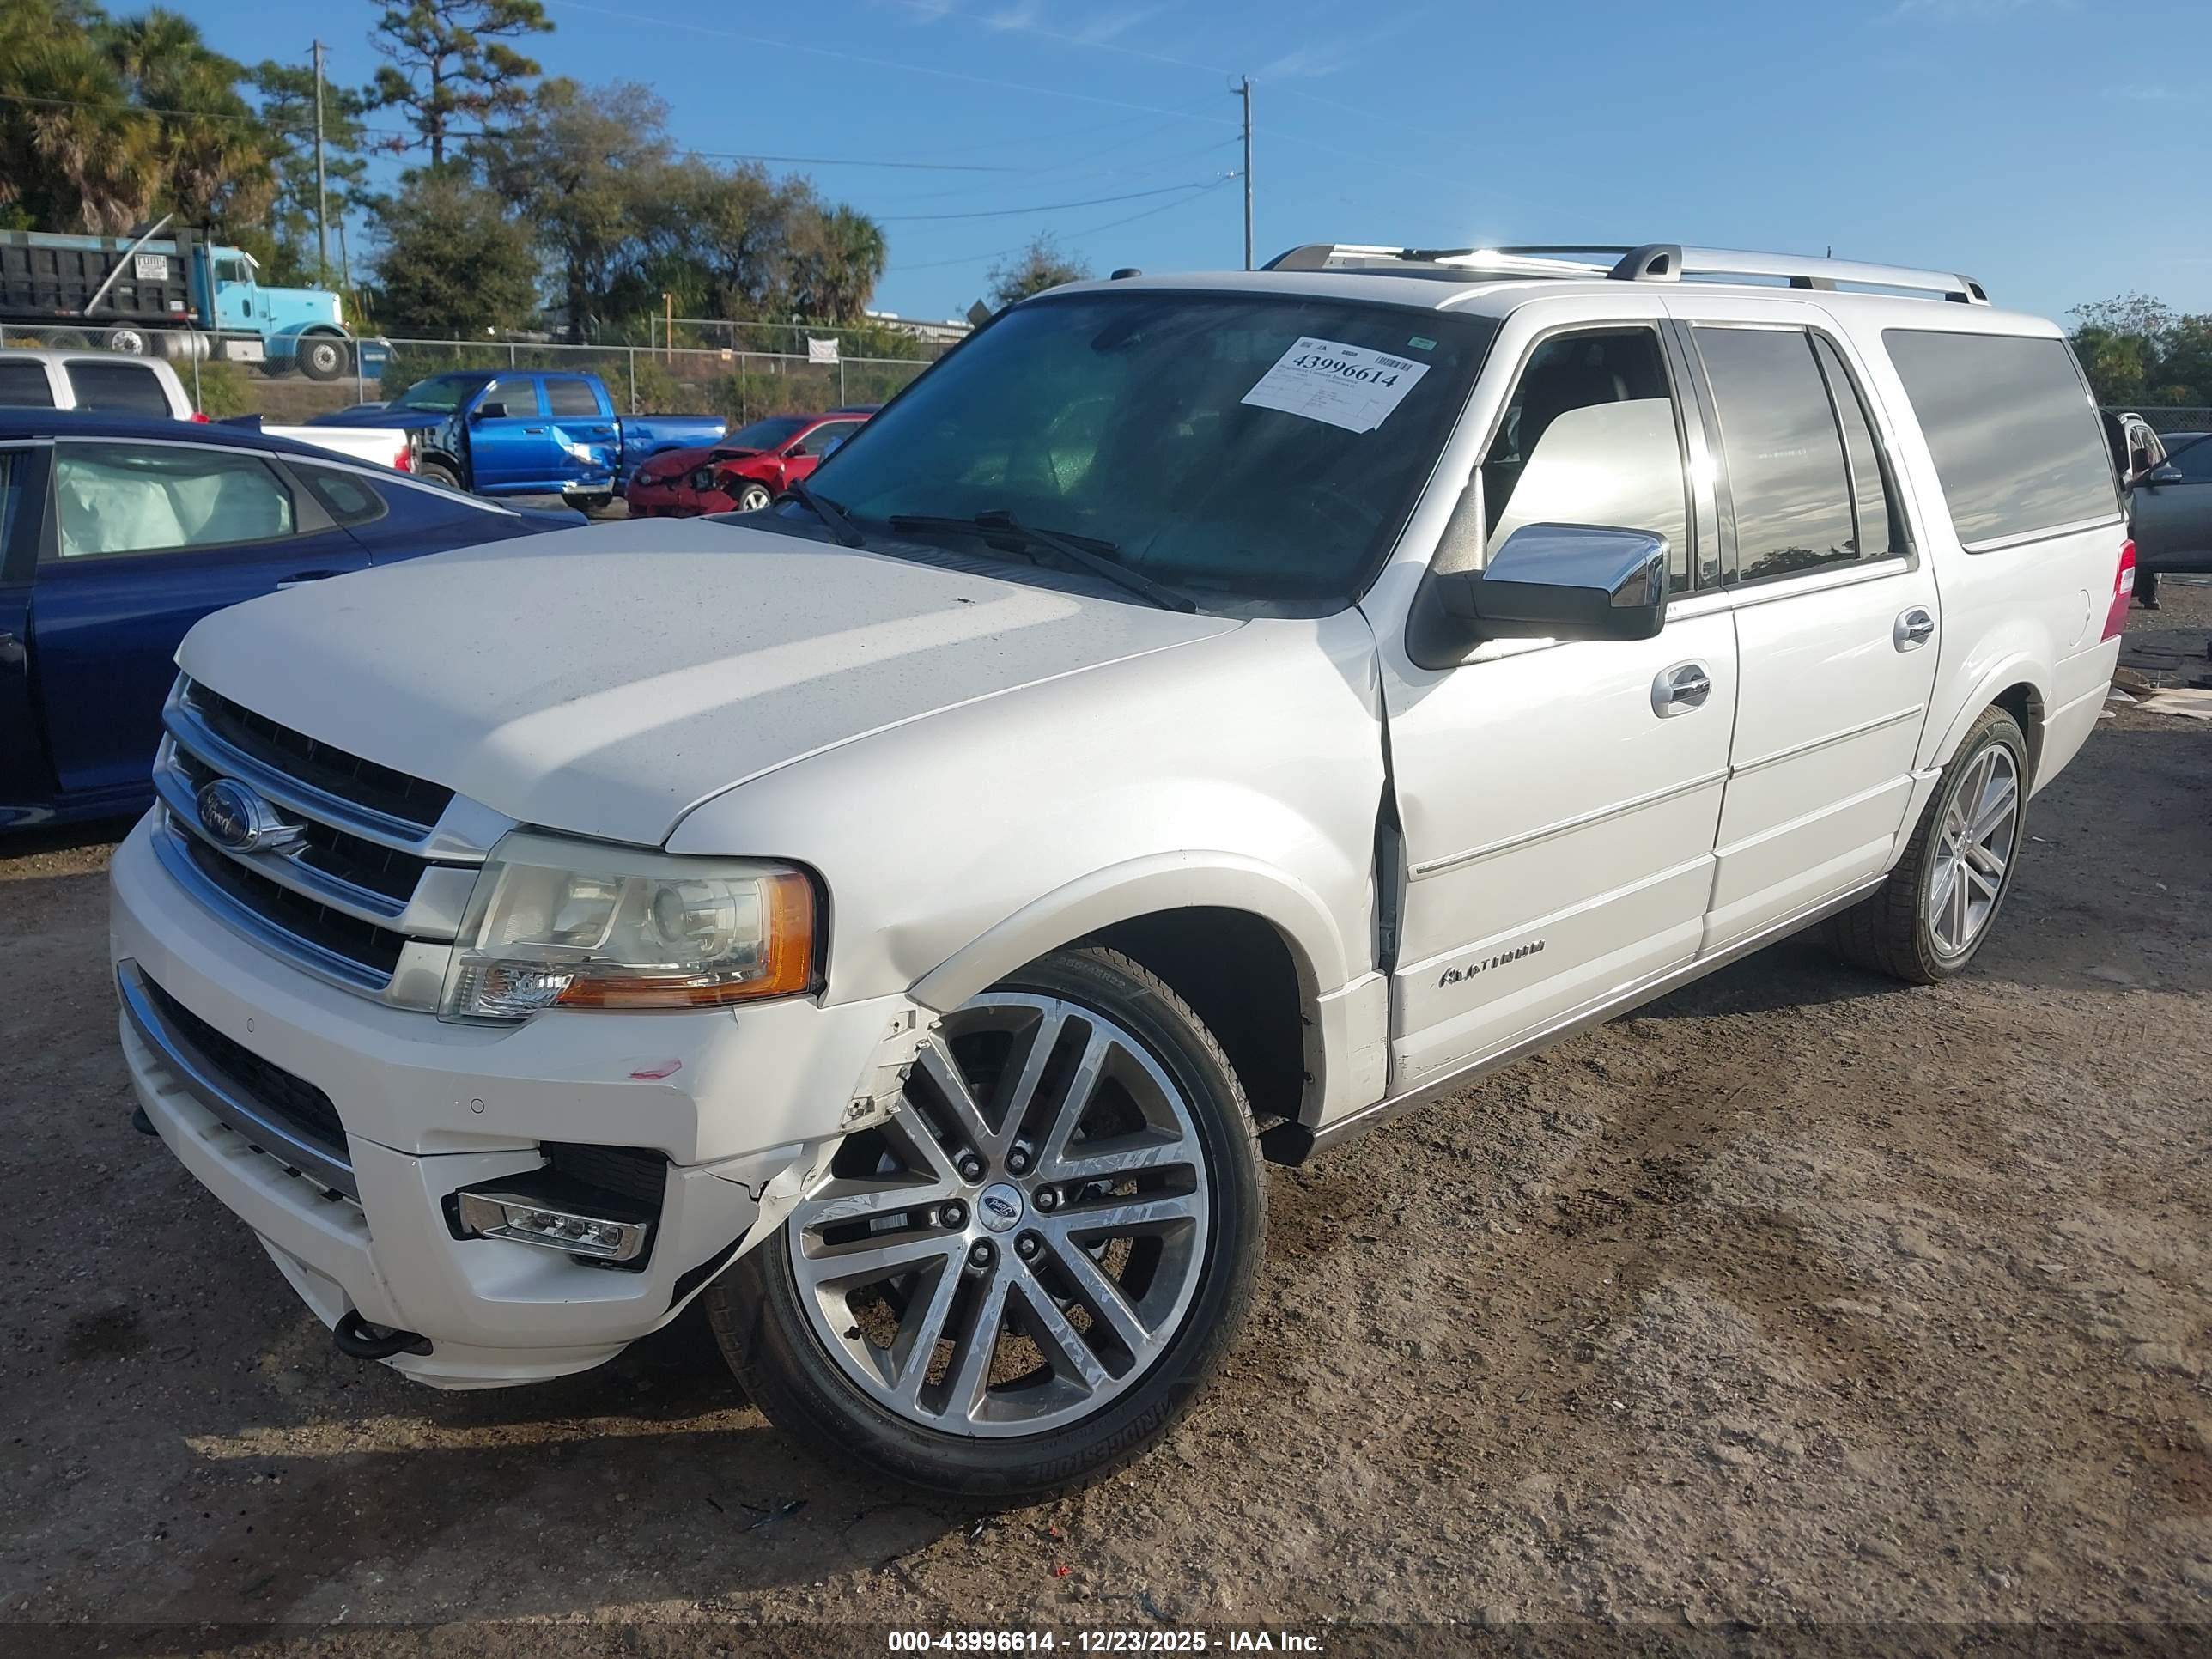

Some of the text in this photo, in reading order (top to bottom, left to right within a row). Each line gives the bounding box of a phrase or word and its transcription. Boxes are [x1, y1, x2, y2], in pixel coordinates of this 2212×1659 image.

[1292, 354, 1400, 388] 43996614
[201, 790, 236, 836] Ford
[988, 1199, 1012, 1216] Ford
